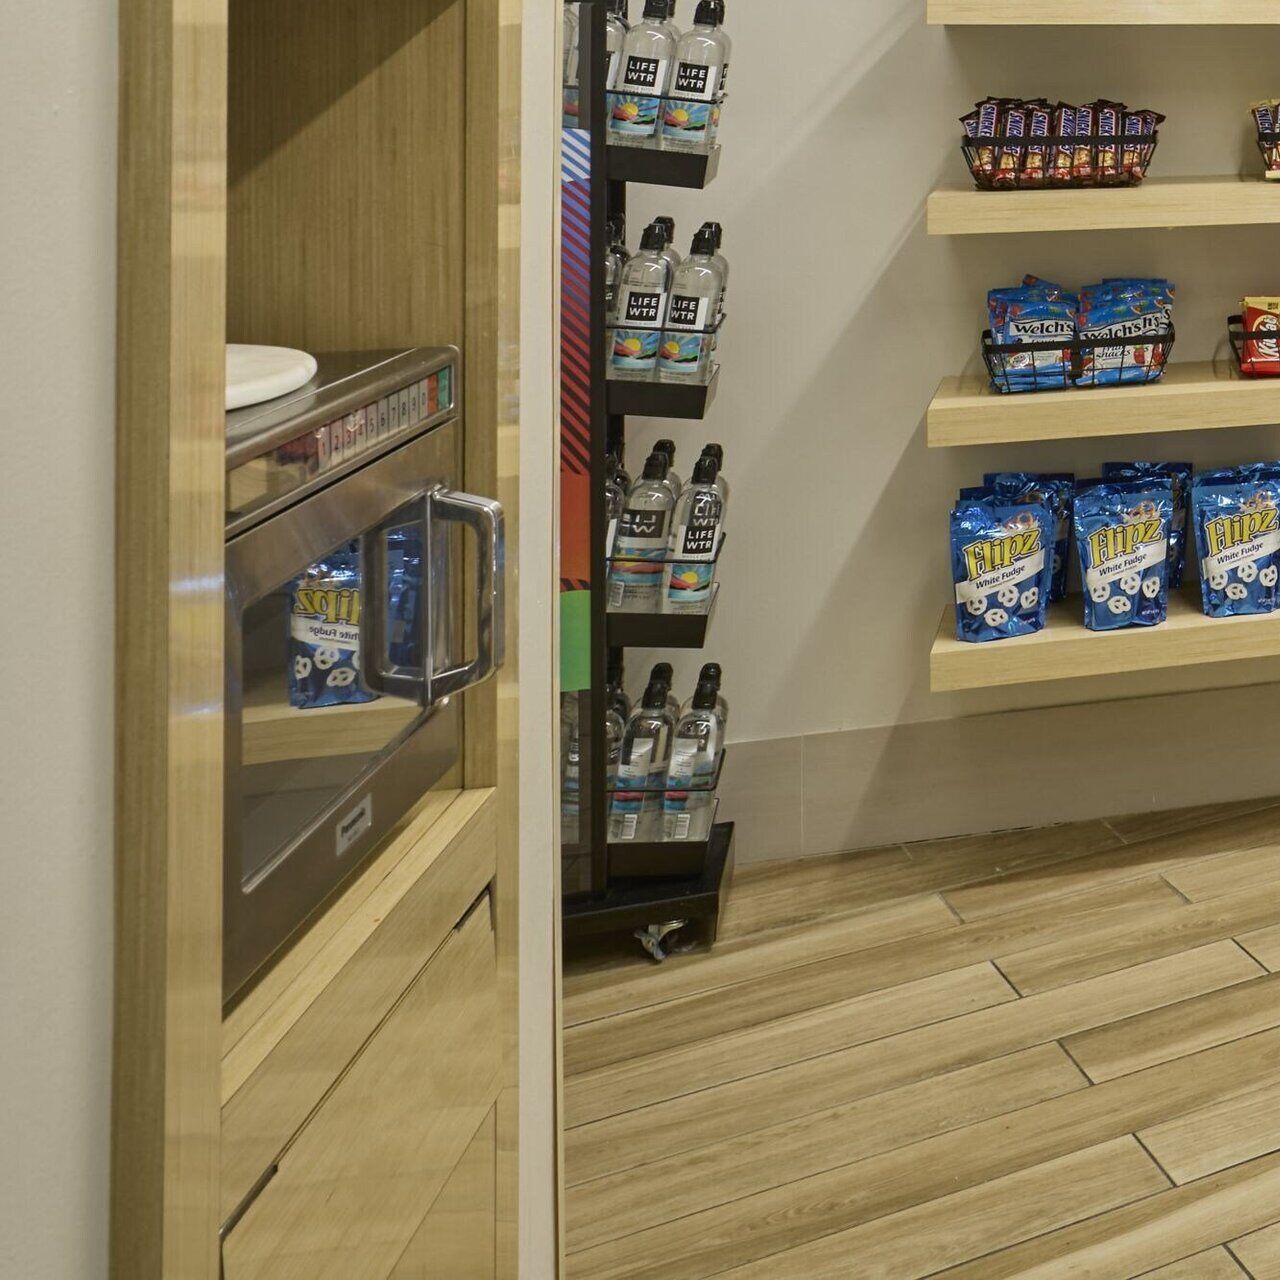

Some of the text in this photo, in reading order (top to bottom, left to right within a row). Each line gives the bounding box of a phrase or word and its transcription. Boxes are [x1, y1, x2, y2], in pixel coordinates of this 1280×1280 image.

[628, 58, 656, 73] LIFE
[680, 65, 706, 79] LIFE
[627, 71, 655, 84] WTR
[678, 77, 705, 91] WTR
[630, 295, 659, 307] LIFE
[672, 298, 697, 311] LIFE
[629, 306, 657, 318] WTR
[671, 309, 696, 321] WTR
[1015, 320, 1075, 336] Welch's
[688, 528, 714, 540] LIFE
[1202, 507, 1280, 557] Flipz
[686, 539, 712, 552] WTR
[1089, 517, 1163, 569] Flipz
[963, 526, 1041, 582] Flipz
[1216, 541, 1265, 565] White Fudge
[1099, 553, 1148, 578] White Fudge
[975, 564, 1026, 590] White Fudge
